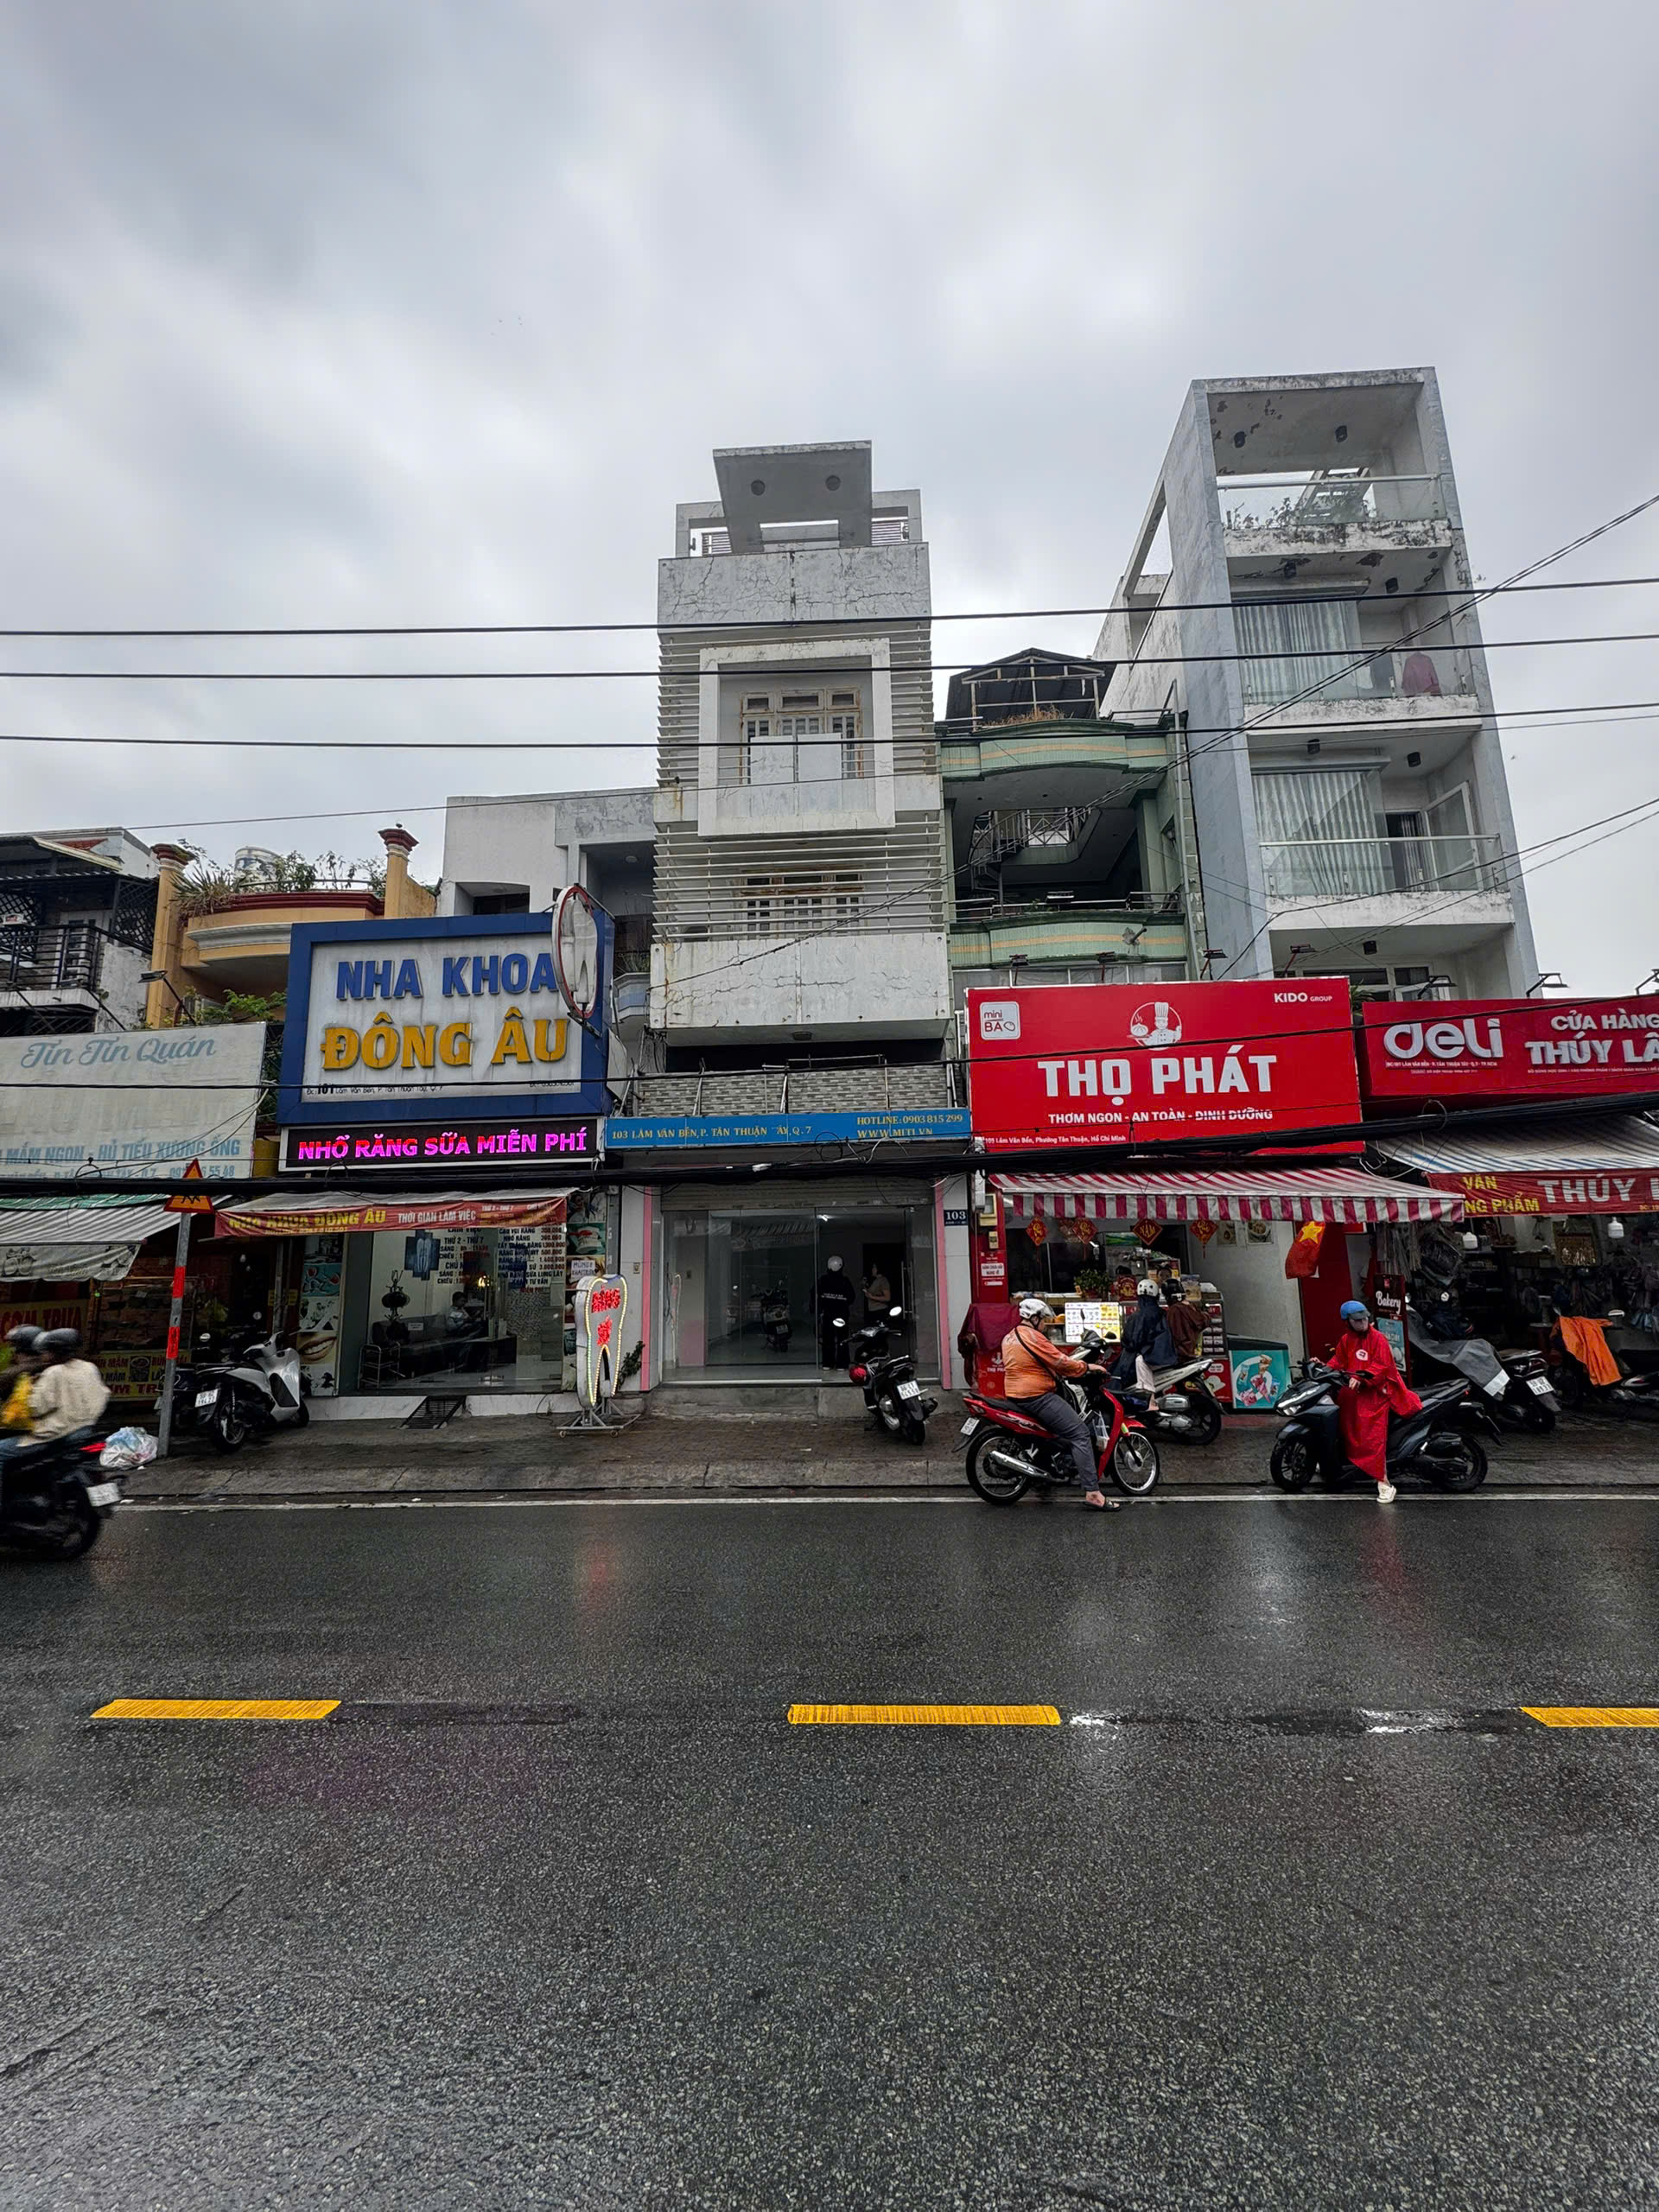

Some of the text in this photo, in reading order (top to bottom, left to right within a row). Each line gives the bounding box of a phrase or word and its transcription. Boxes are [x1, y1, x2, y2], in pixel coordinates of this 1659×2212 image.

[335, 952, 558, 1001] NHA KHOA
[1274, 992, 1307, 1003] KIDO
[984, 1009, 1003, 1019] mini
[1551, 1010, 1597, 1031] CỬA
[320, 1006, 570, 1071] ĐÔNG ÂU
[1383, 1018, 1504, 1059] deli
[1524, 1031, 1614, 1065] THÚY
[1037, 1045, 1278, 1106] THỌ PHÁT
[926, 1114, 944, 1124] 815
[945, 1114, 963, 1122] 299
[1048, 1112, 1085, 1124] THƠM
[1087, 1111, 1122, 1123] NGON
[1131, 1112, 1150, 1122] AN
[1151, 1108, 1185, 1122] TOÀN
[1195, 1110, 1226, 1121] DINH
[298, 1127, 588, 1160] NHỔ RĂNG SỮA MIỄN PHÍ
[612, 1130, 628, 1140] 103
[632, 1128, 653, 1140] LÂM
[711, 1125, 730, 1136] TÂN
[734, 1126, 767, 1138] THUẬN
[1537, 1173, 1636, 1204] THÚY
[363, 1208, 387, 1224] ÂU
[397, 1211, 416, 1224] THỜI
[417, 1211, 438, 1223] GIAN
[438, 1210, 457, 1222] LÀM
[458, 1208, 477, 1222] VIỆC
[945, 1211, 967, 1221] 103
[1376, 1290, 1402, 1315] Bakery
